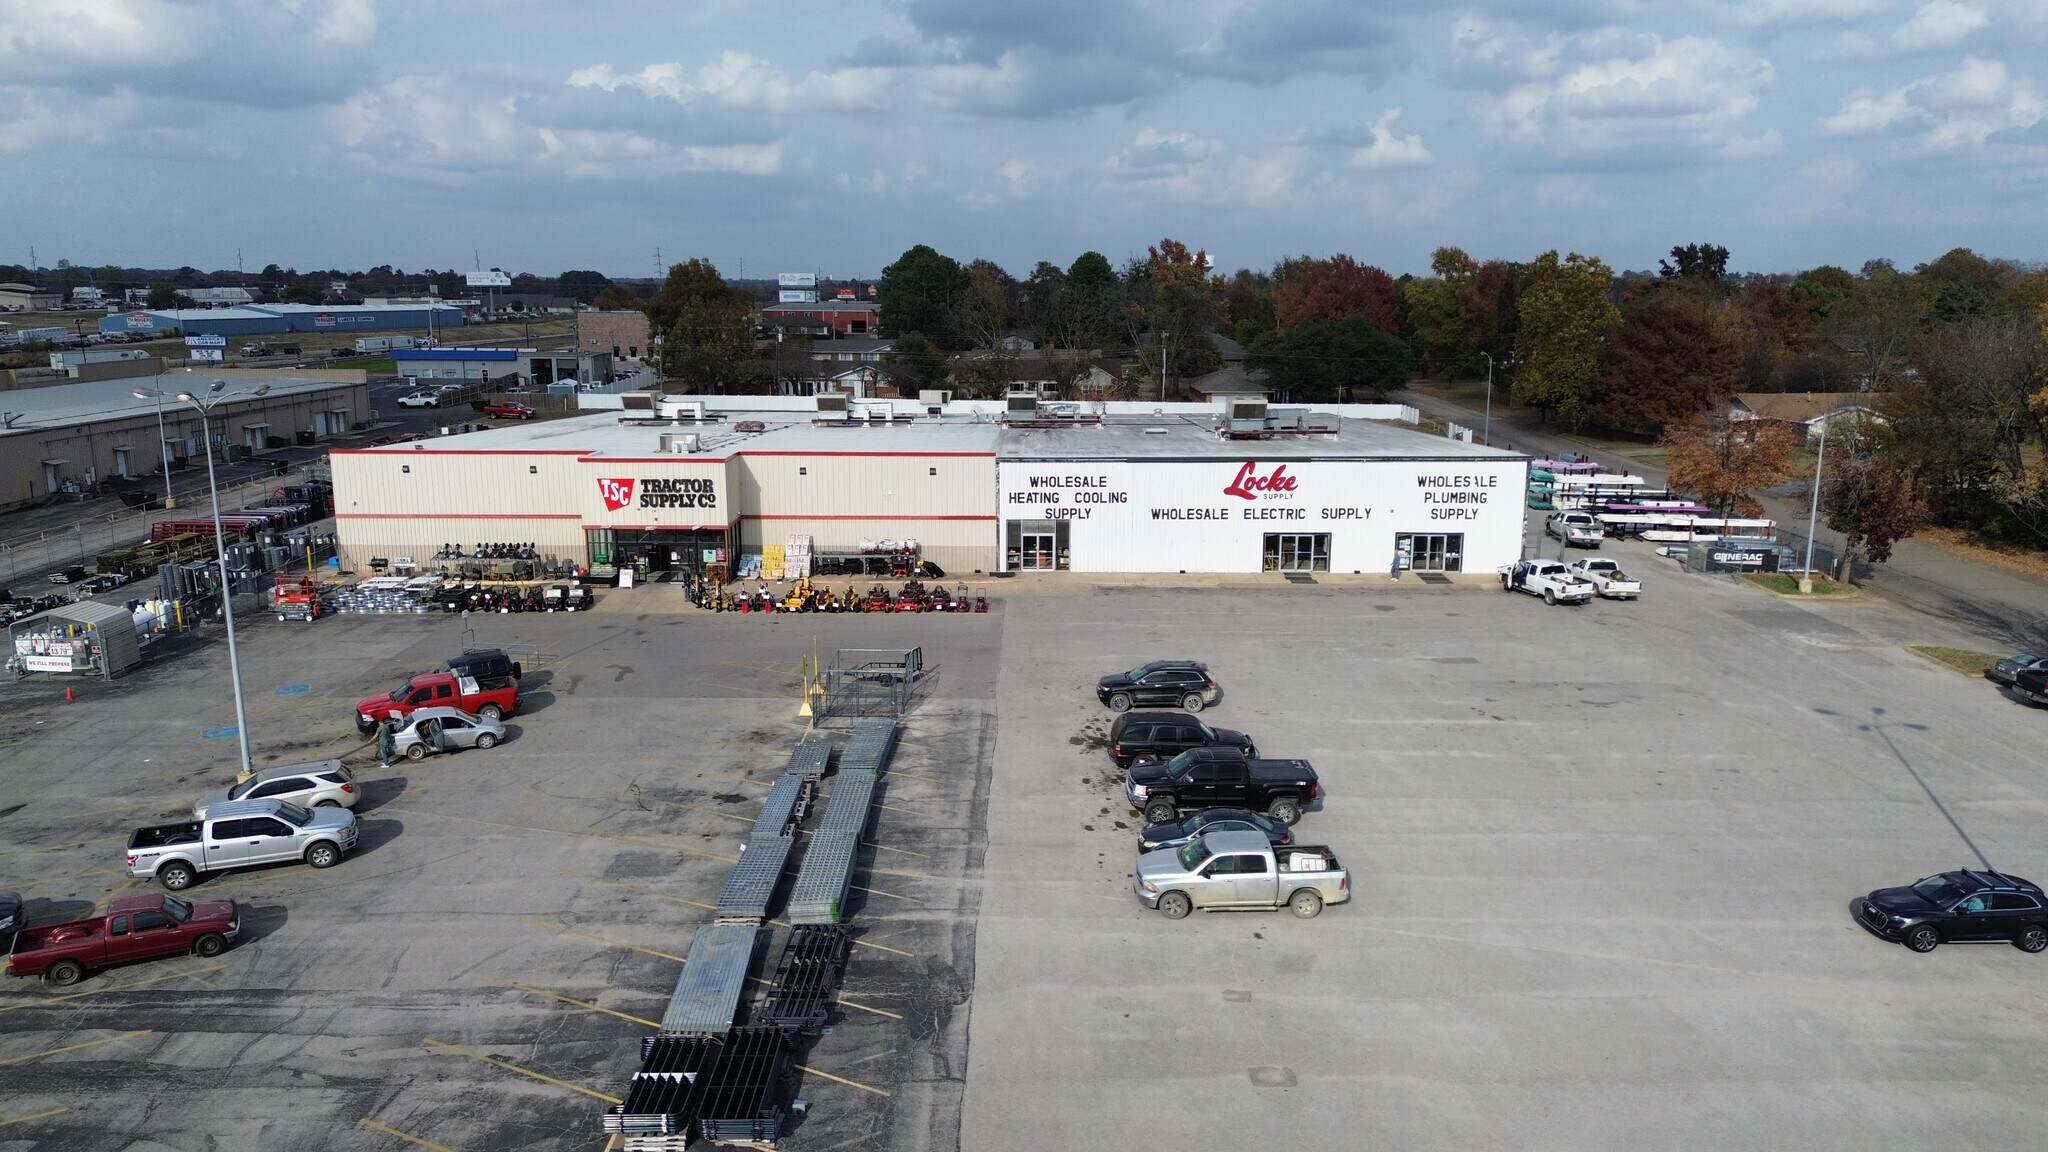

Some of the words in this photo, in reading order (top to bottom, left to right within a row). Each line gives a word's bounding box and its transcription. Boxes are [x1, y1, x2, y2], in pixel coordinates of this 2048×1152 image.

[640, 478, 714, 493] TRACTOR
[1029, 476, 1107, 488] WHOLESALE
[1223, 461, 1298, 500] Locke
[601, 479, 629, 506] TSC
[1009, 492, 1060, 504] HEATING
[1074, 492, 1128, 504] COOLING
[1424, 492, 1487, 504] PLUMBING
[640, 493, 697, 508] SUPPLY
[1045, 508, 1092, 520] SUPPLY
[1151, 508, 1229, 521] WHOLESALE
[1243, 508, 1306, 520] ELECTRIC
[1321, 507, 1372, 520] SUPPLY
[1431, 508, 1479, 520] SUPPLY
[1714, 552, 1763, 561] GENERAC
